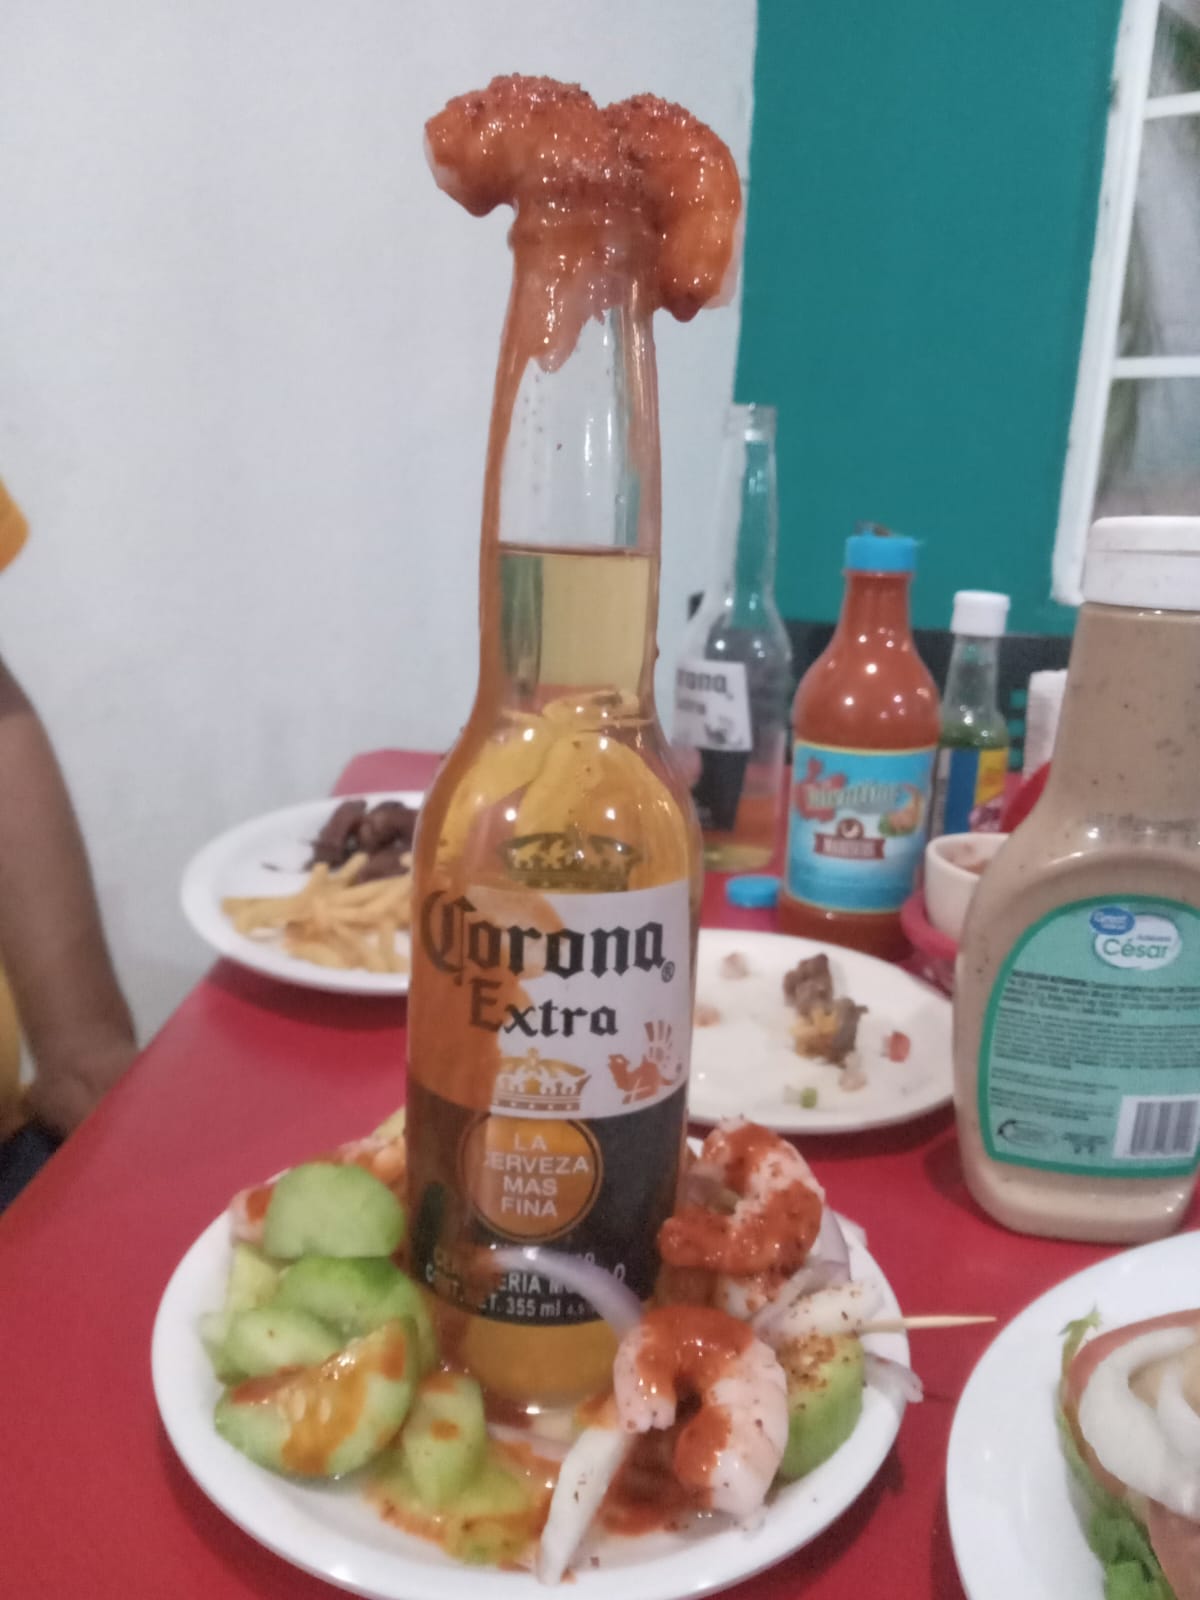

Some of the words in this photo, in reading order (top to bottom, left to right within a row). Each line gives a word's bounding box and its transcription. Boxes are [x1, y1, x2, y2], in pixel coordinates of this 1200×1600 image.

[420, 890, 666, 986] Corona
[1103, 937, 1169, 959] César
[469, 978, 618, 1037] Extra
[514, 1133, 547, 1152] LA
[503, 1175, 558, 1196] MAS
[501, 1196, 558, 1217] FINA
[506, 1296, 536, 1317] 355
[540, 1299, 561, 1317] ml
